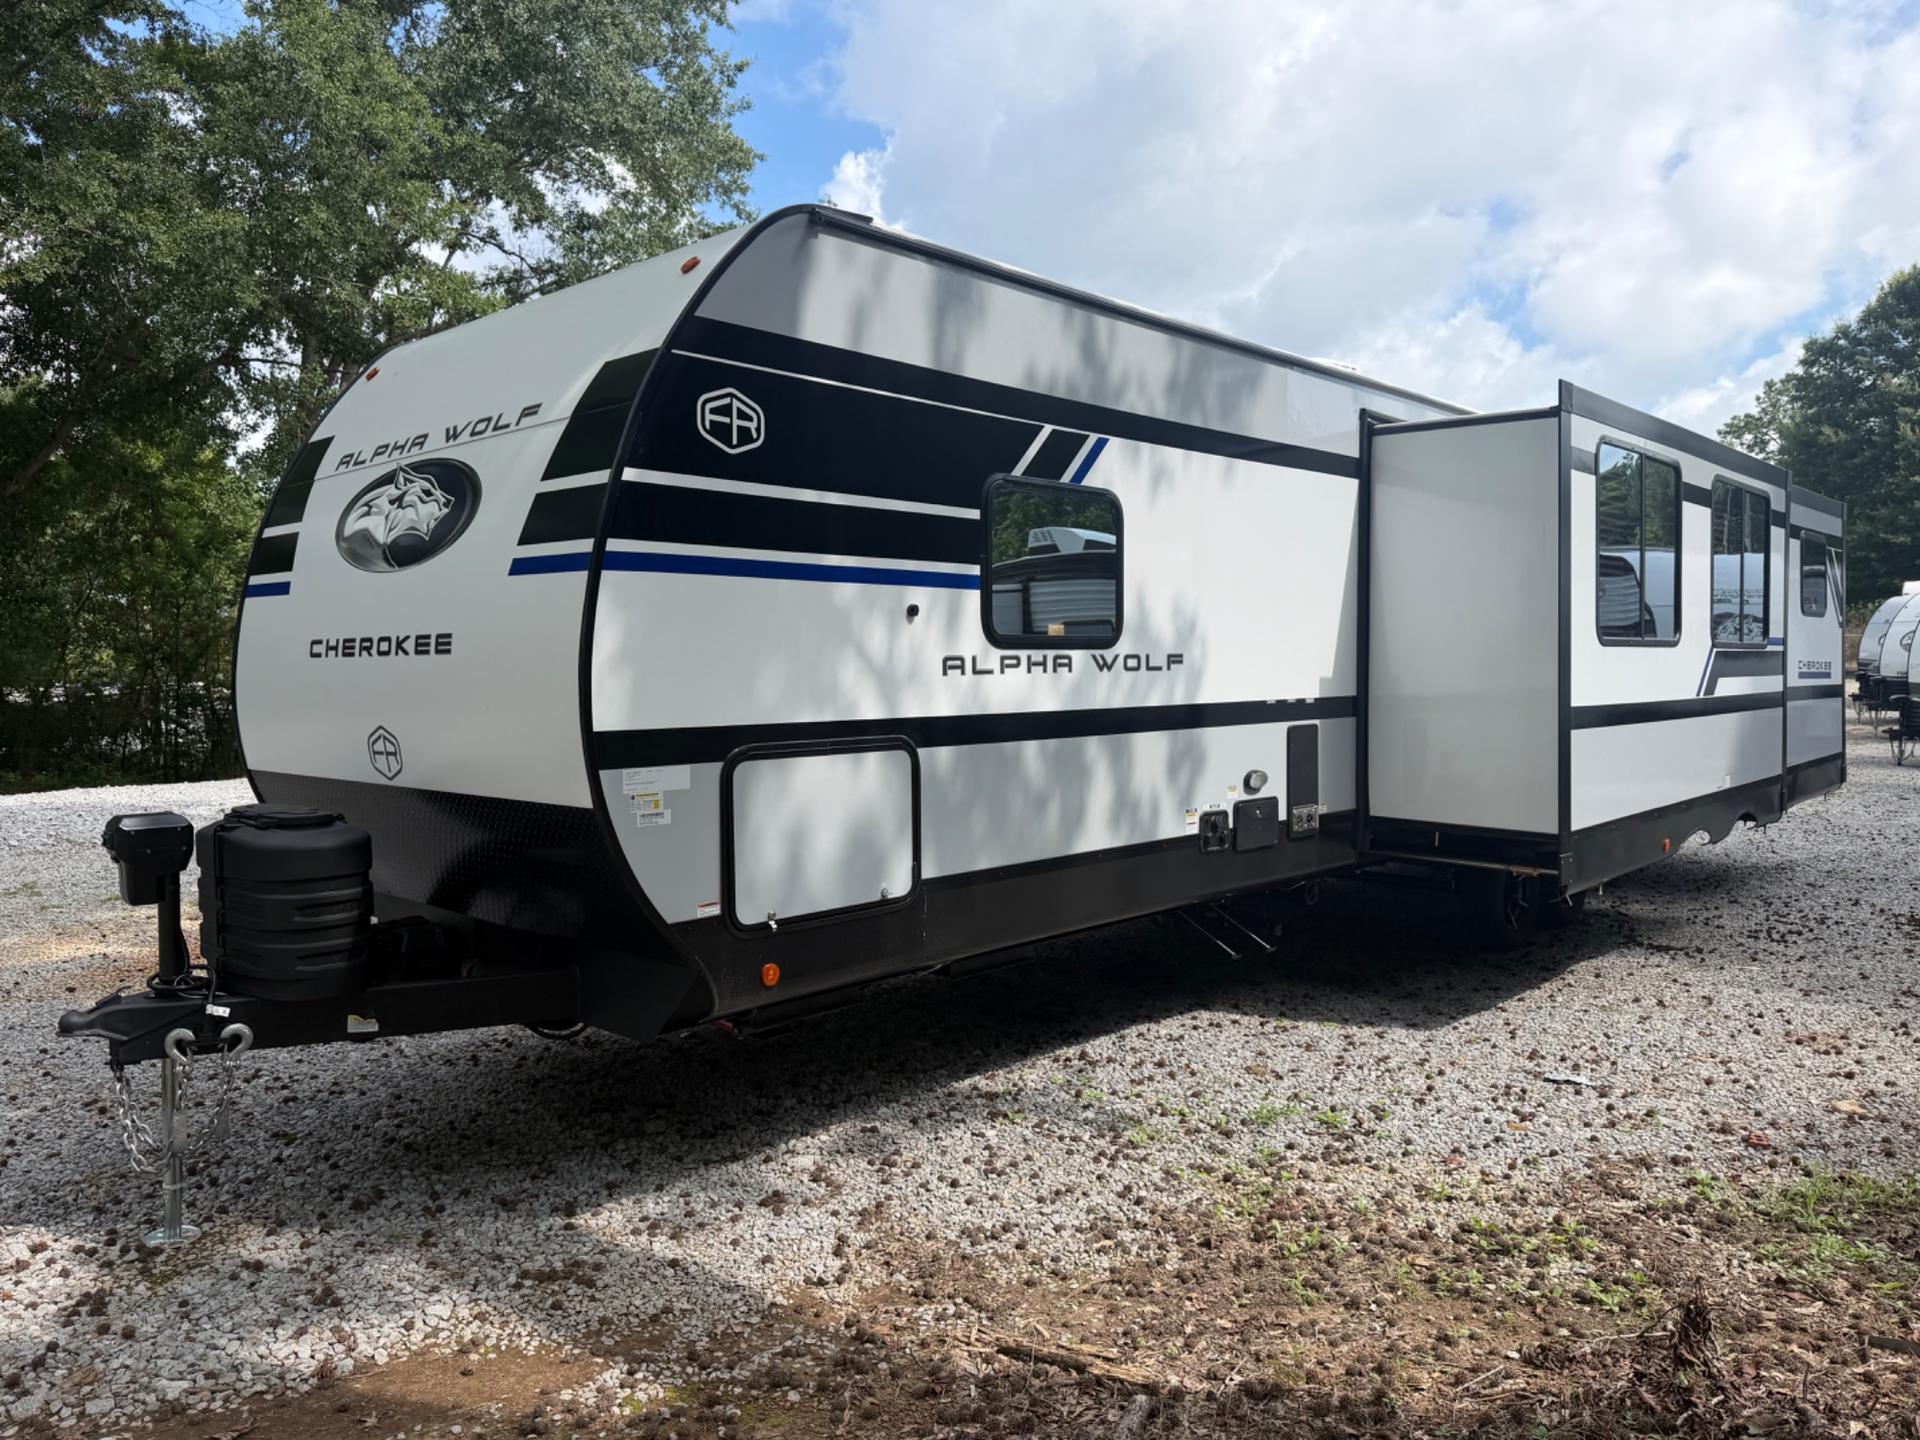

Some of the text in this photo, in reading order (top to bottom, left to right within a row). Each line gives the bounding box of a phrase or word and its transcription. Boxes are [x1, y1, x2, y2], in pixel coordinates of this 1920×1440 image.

[335, 402, 543, 472] ALPHA WOLF
[310, 633, 452, 658] CHEROKEE
[943, 653, 1184, 676] ALPHA WOLF
[1798, 660, 1832, 670] CHEROKEE
